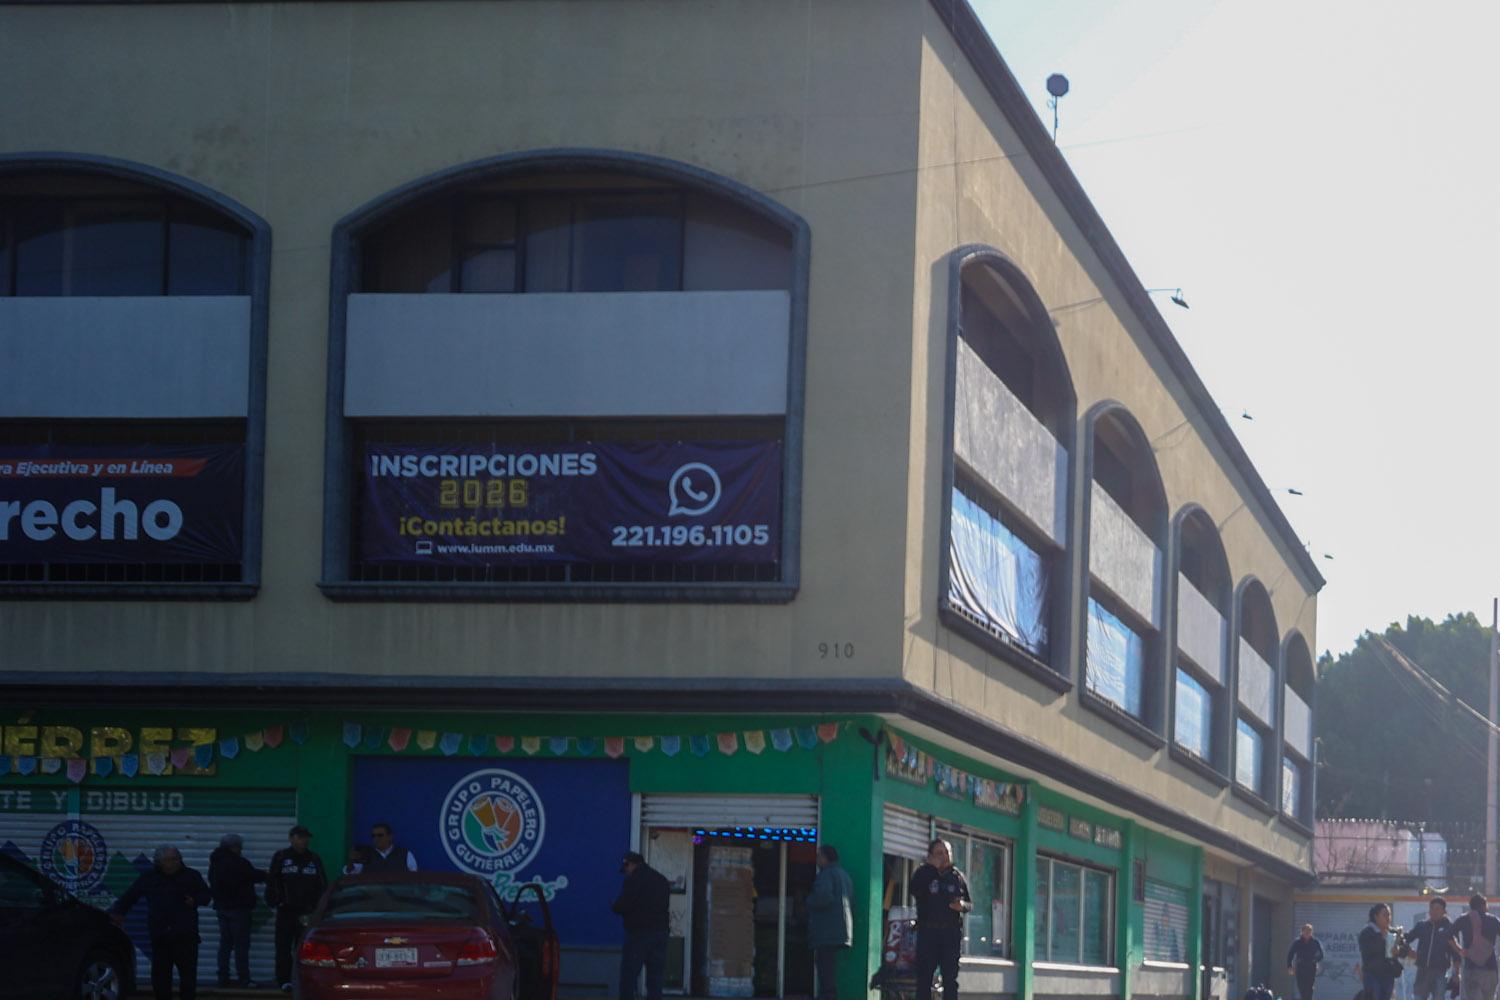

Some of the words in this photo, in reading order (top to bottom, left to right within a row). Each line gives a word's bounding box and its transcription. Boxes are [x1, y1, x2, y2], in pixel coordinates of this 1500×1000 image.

[16, 461, 88, 477] Ejecutiva
[92, 465, 102, 477] y
[107, 464, 126, 474] en
[130, 460, 173, 474] Línea
[371, 453, 597, 477] INSCRIPCIONES
[440, 479, 528, 508] 2026
[0, 487, 183, 541] recho
[400, 516, 566, 537] ¡Contáctanos!
[612, 524, 768, 547] 221.196.1105
[818, 642, 856, 659] 910
[0, 712, 217, 776] ÉRREZ
[51, 790, 68, 810] Y
[86, 791, 185, 812] DIBUJO
[447, 781, 482, 840] GRUPO
[490, 776, 538, 840] PAPELERO
[455, 843, 530, 870] GUTIÉRREZ
